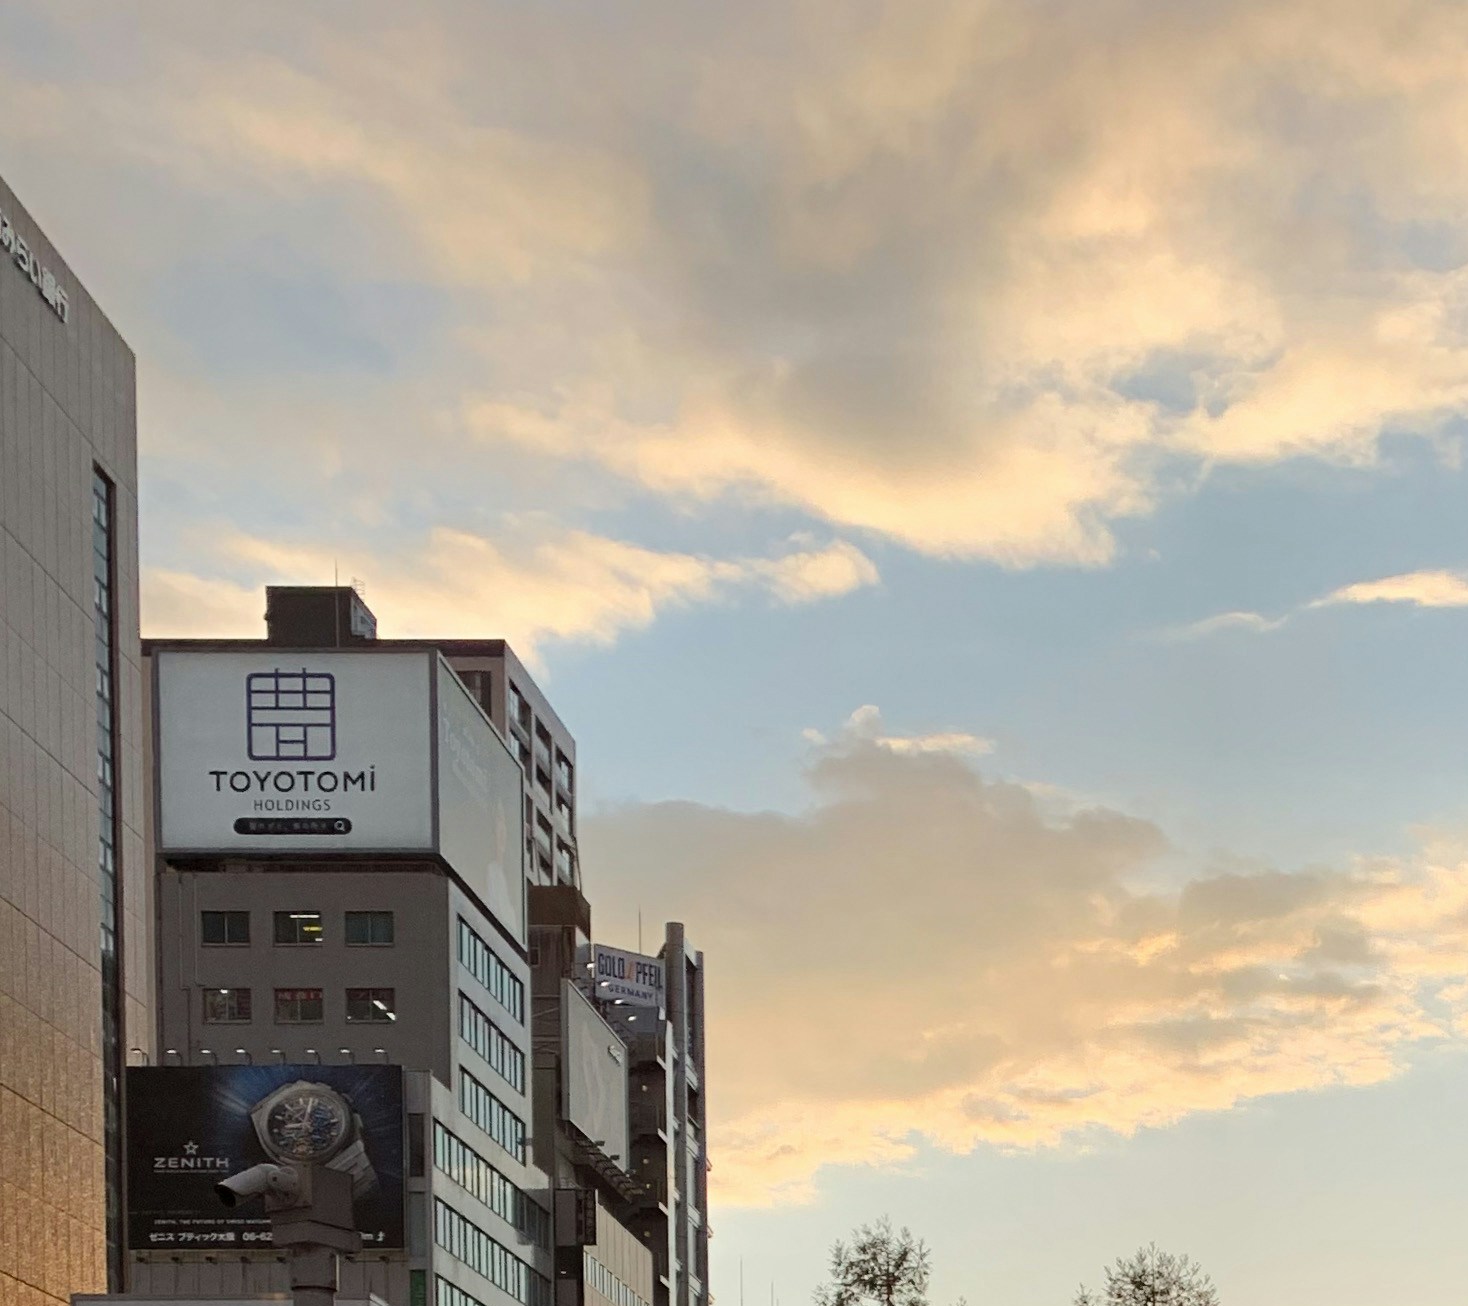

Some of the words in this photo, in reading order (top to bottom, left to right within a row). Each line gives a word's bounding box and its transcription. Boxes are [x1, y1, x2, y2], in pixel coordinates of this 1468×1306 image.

[0, 208, 69, 324] みらい銀行
[253, 799, 332, 812] HOLDINGS
[598, 953, 625, 980] GOLD
[608, 983, 654, 1000] GERMANY
[153, 1157, 230, 1168] ZENITH
